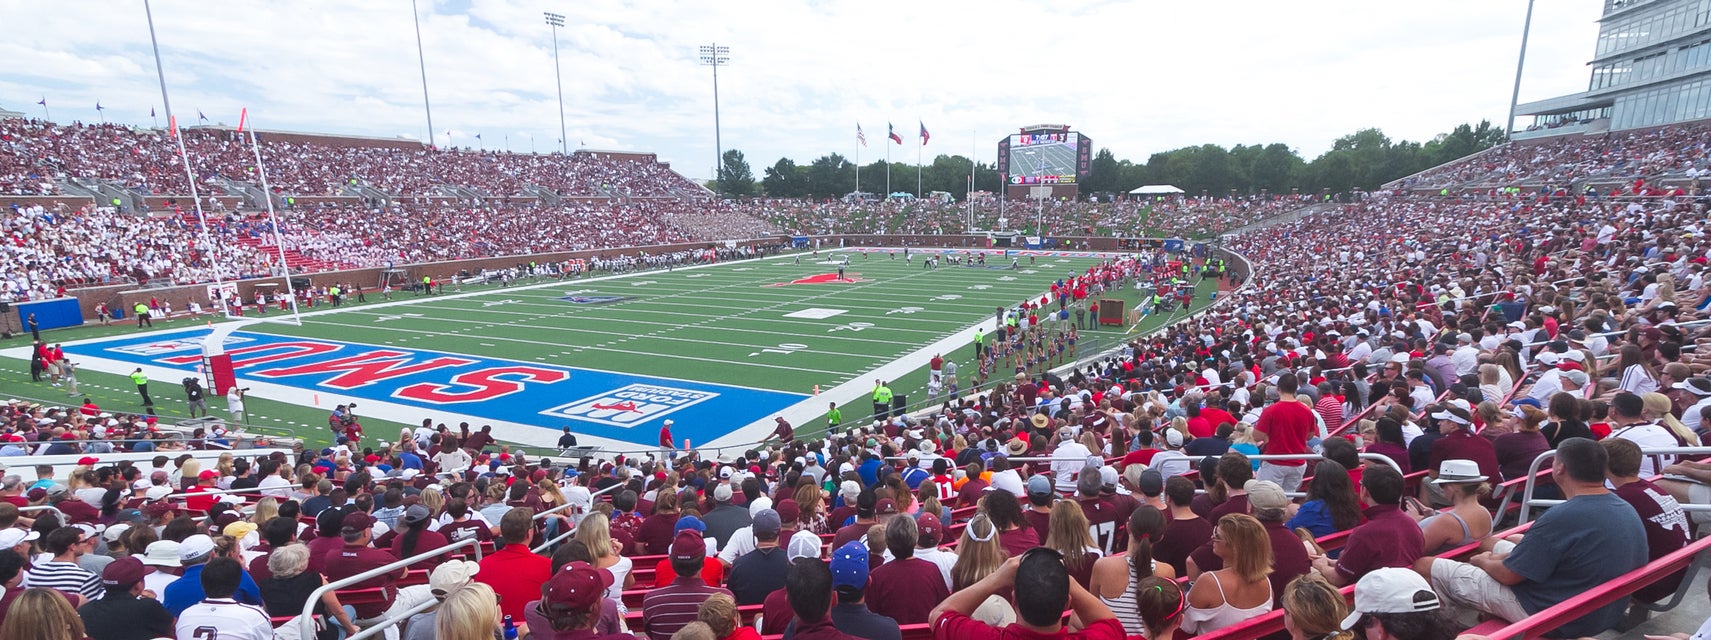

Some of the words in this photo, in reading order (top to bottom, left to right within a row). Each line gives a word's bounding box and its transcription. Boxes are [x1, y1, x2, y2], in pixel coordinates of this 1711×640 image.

[152, 340, 571, 405] SMU
[613, 391, 691, 405] FORD
[627, 386, 705, 399] STADIUM
